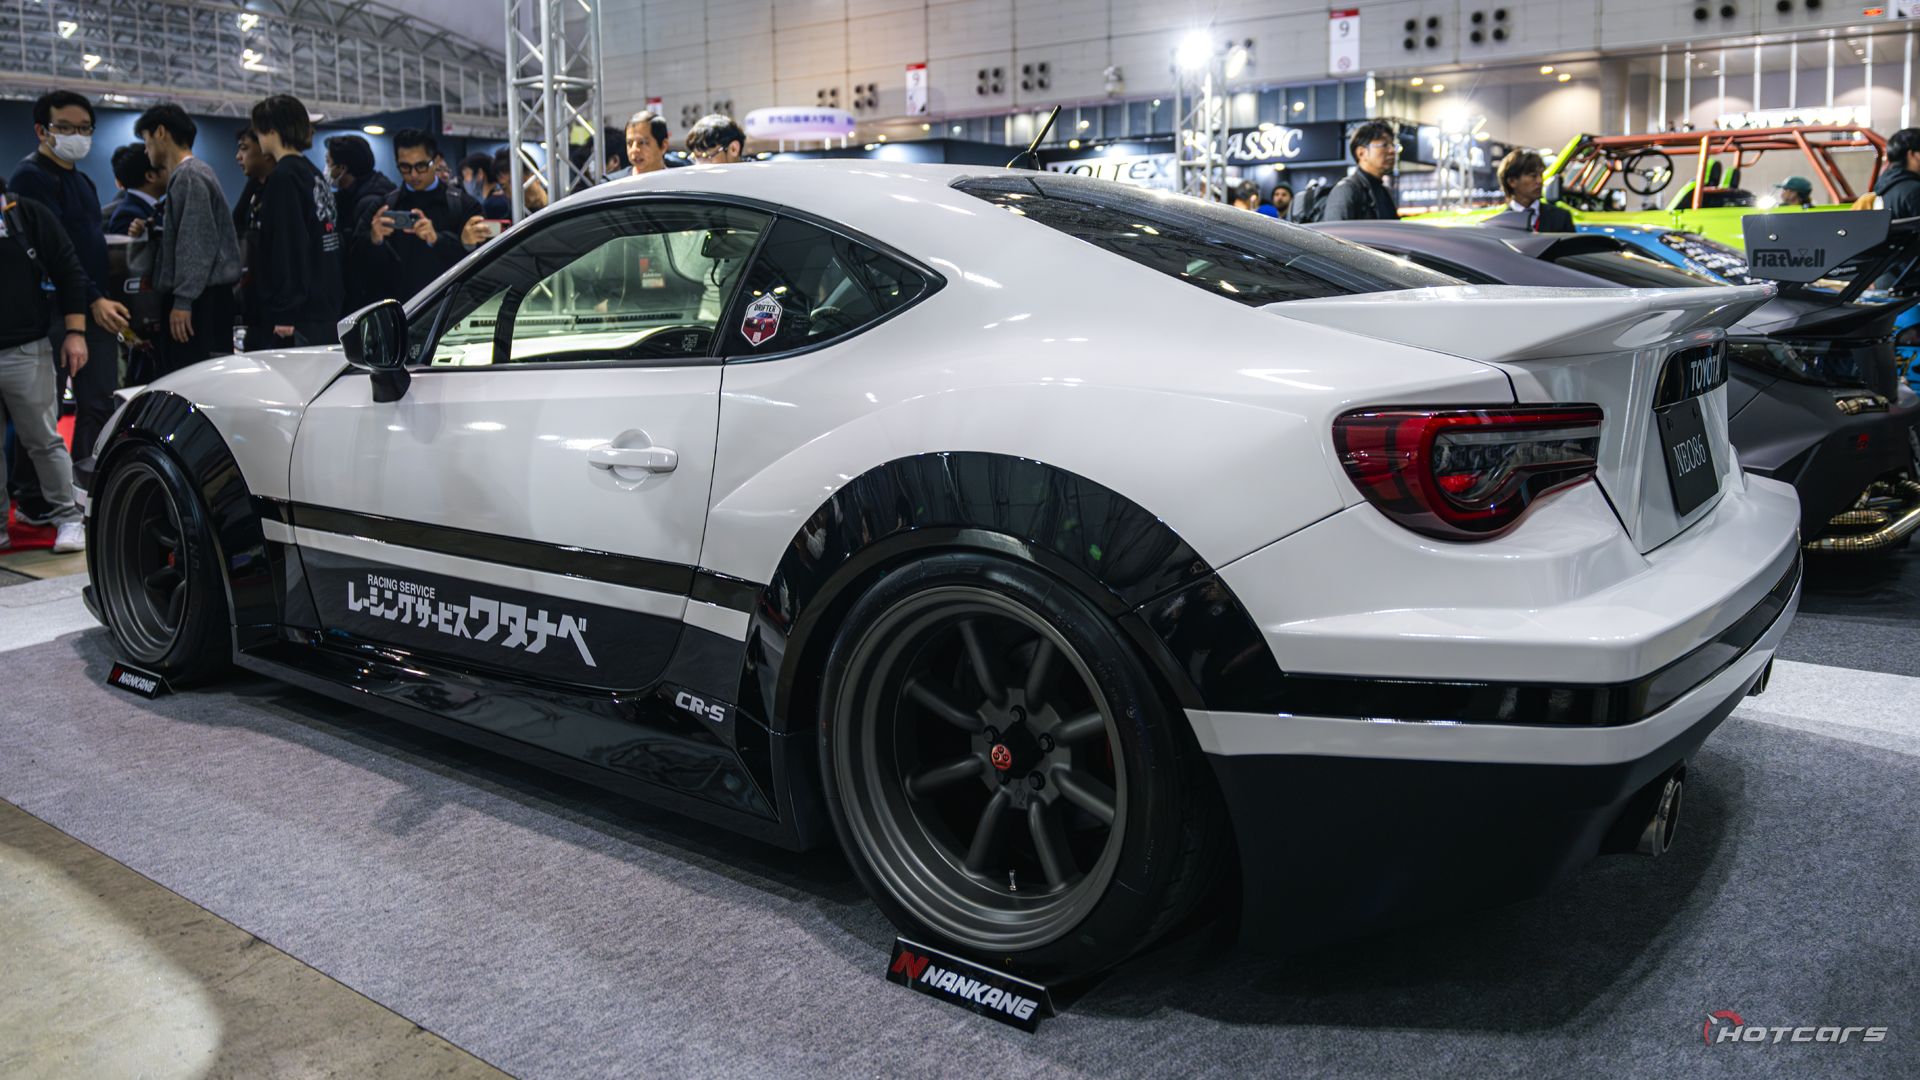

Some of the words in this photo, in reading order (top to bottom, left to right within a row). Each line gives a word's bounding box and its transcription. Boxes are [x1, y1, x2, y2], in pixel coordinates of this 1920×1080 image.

[1339, 20, 1350, 38] 9
[1051, 158, 1175, 181] OLTEX
[1690, 354, 1720, 392] TOYOTA
[1673, 434, 1707, 477] NEO86
[367, 573, 398, 591] RACING
[399, 580, 436, 599] SERVICE
[118, 671, 157, 693] NANKANG
[920, 965, 1038, 1021] NANKANG
